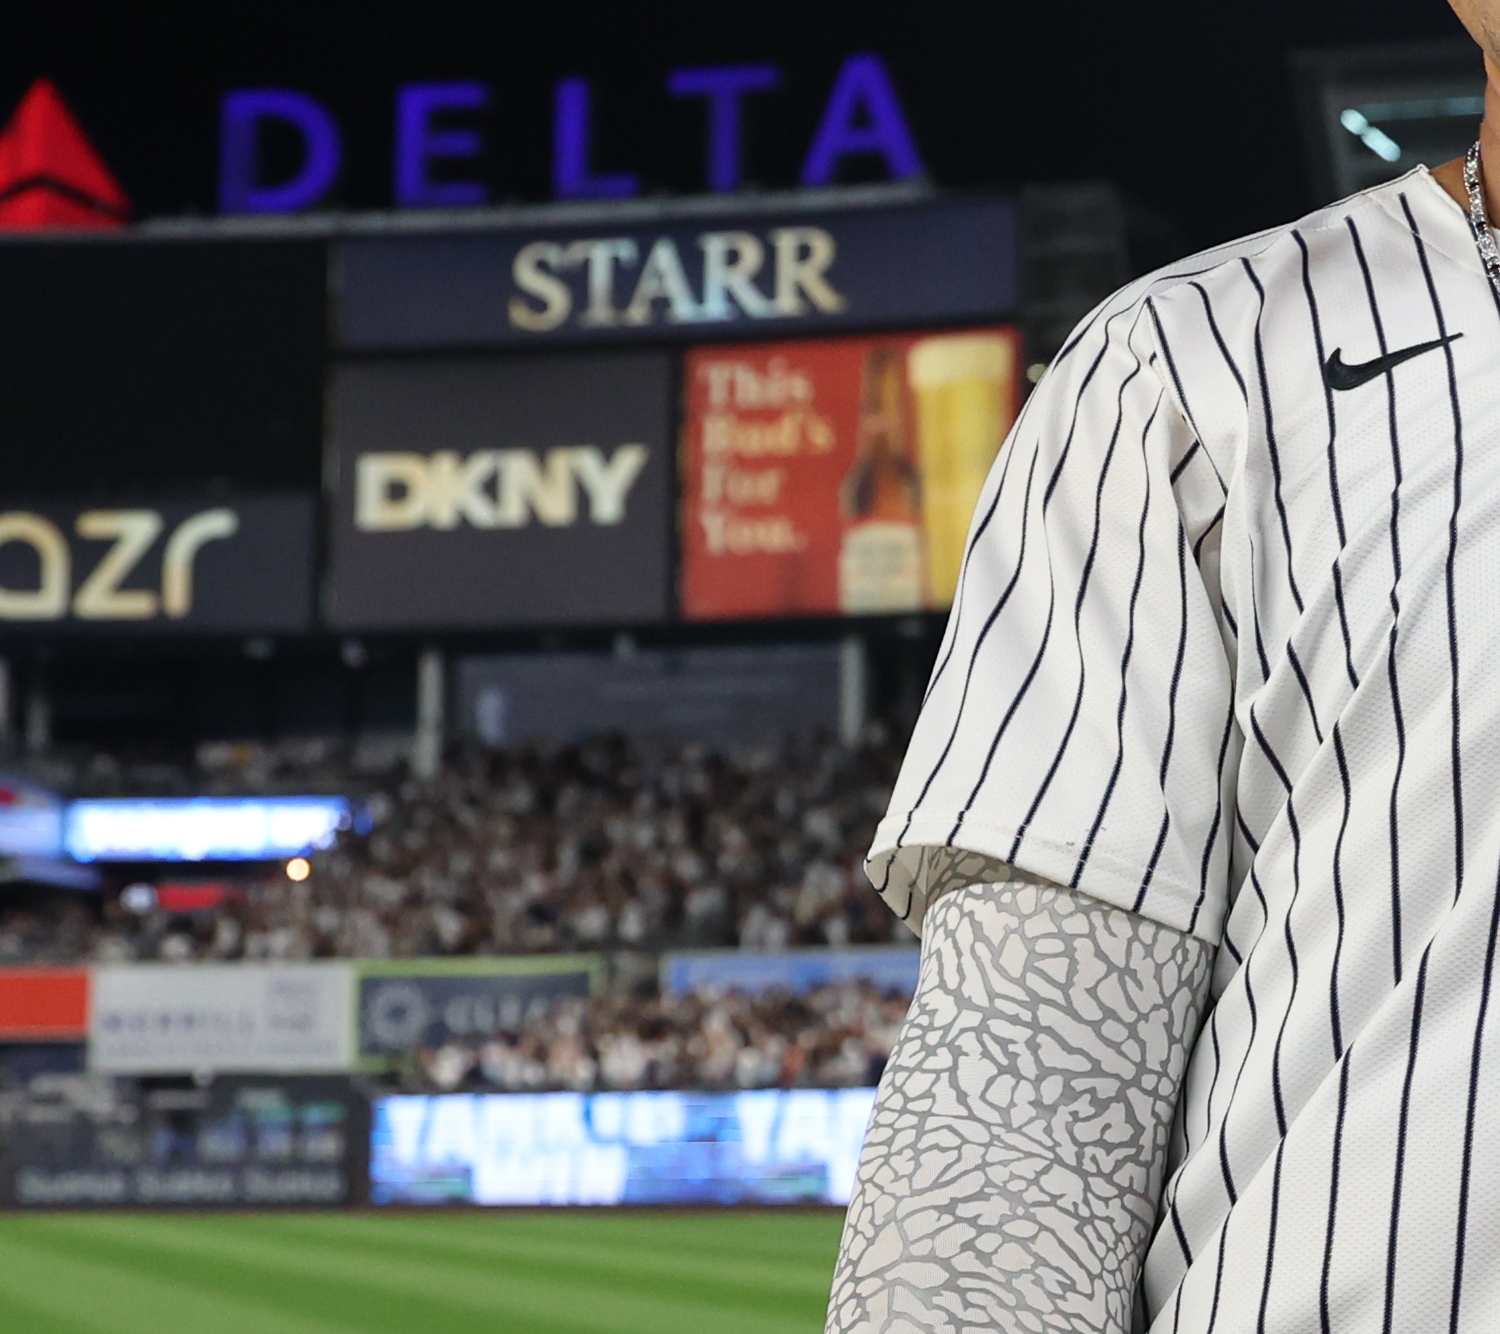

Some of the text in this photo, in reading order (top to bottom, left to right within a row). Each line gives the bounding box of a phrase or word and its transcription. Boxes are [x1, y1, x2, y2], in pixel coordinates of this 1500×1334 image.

[218, 54, 924, 214] DELTA
[509, 228, 846, 332] STARR
[698, 356, 818, 409] This
[354, 442, 651, 532] DKNY
